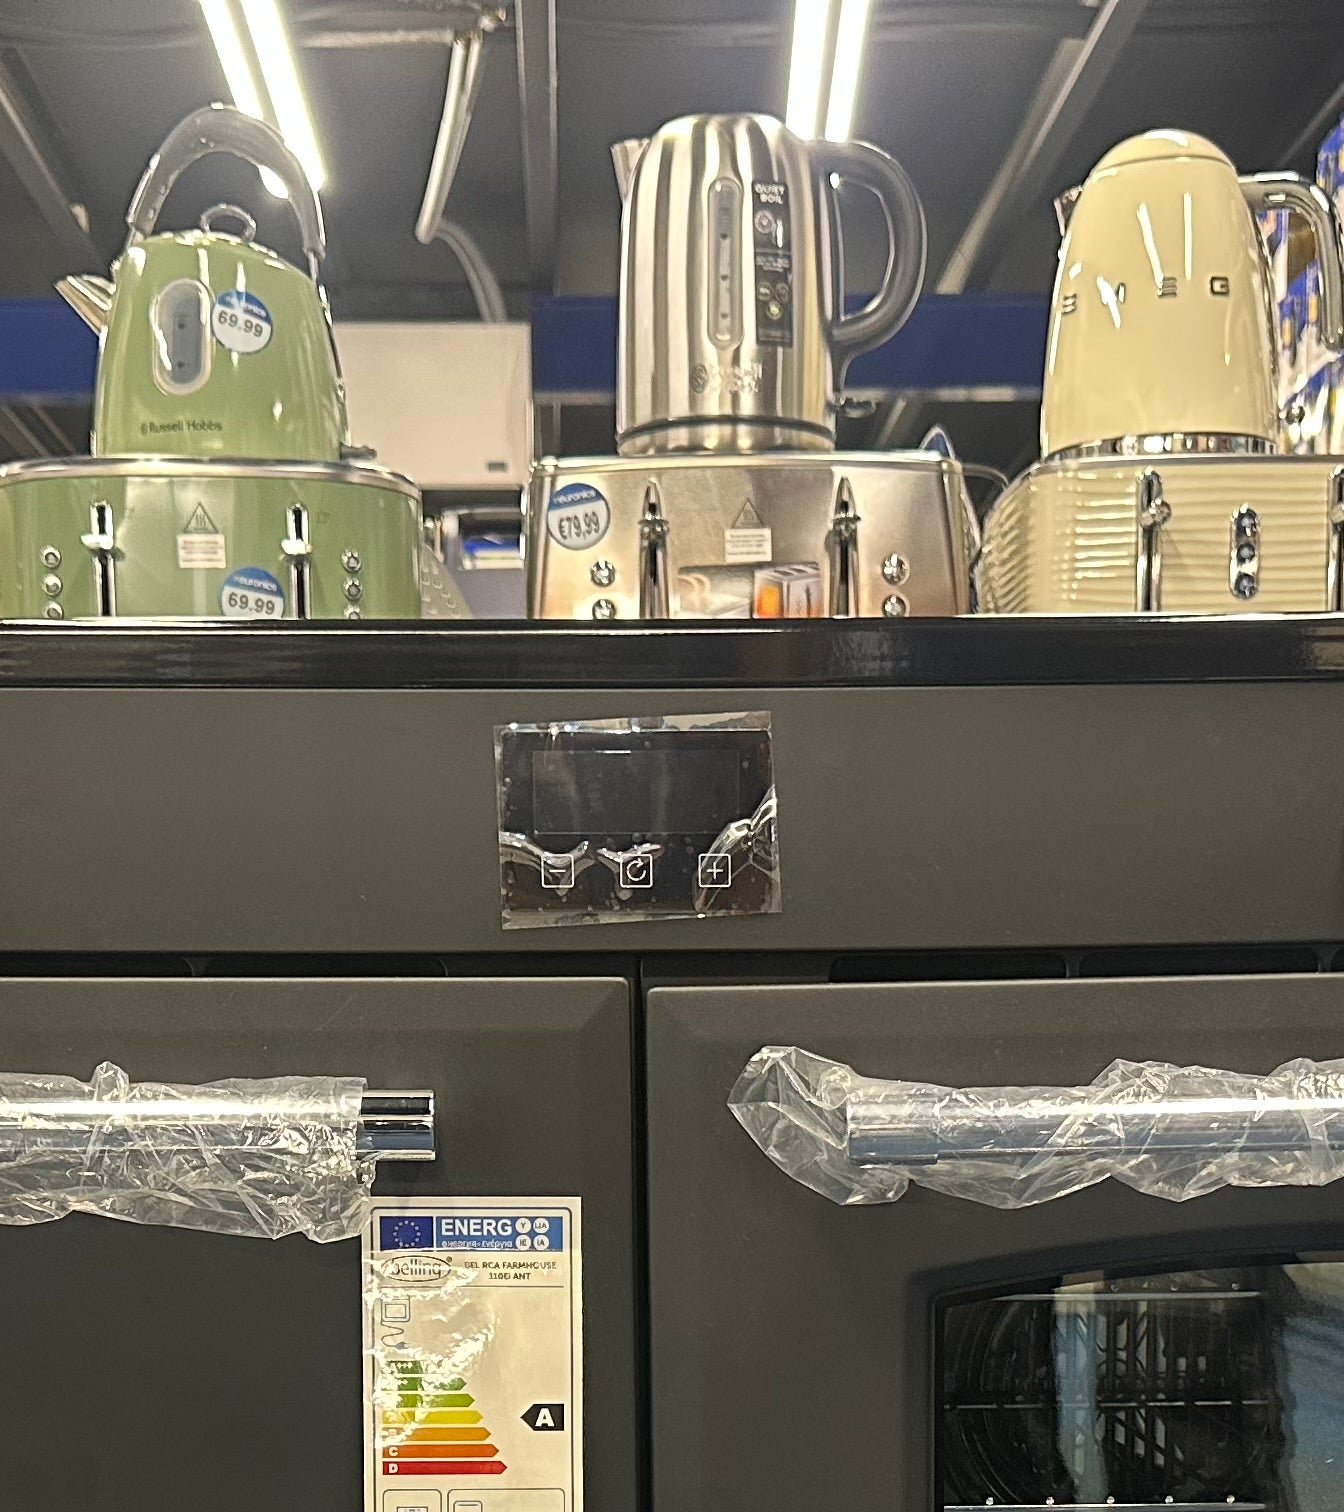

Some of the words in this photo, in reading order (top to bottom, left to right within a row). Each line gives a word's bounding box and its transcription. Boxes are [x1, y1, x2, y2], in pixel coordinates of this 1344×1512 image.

[218, 310, 263, 338] 69.99
[228, 592, 275, 615] 69.99
[441, 1218, 512, 1236] ENERG
[502, 1261, 557, 1269] FARMHOUSE
[513, 1272, 531, 1280] ANT
[535, 1408, 555, 1427] A
[388, 1447, 399, 1457] C
[388, 1463, 399, 1474] D
